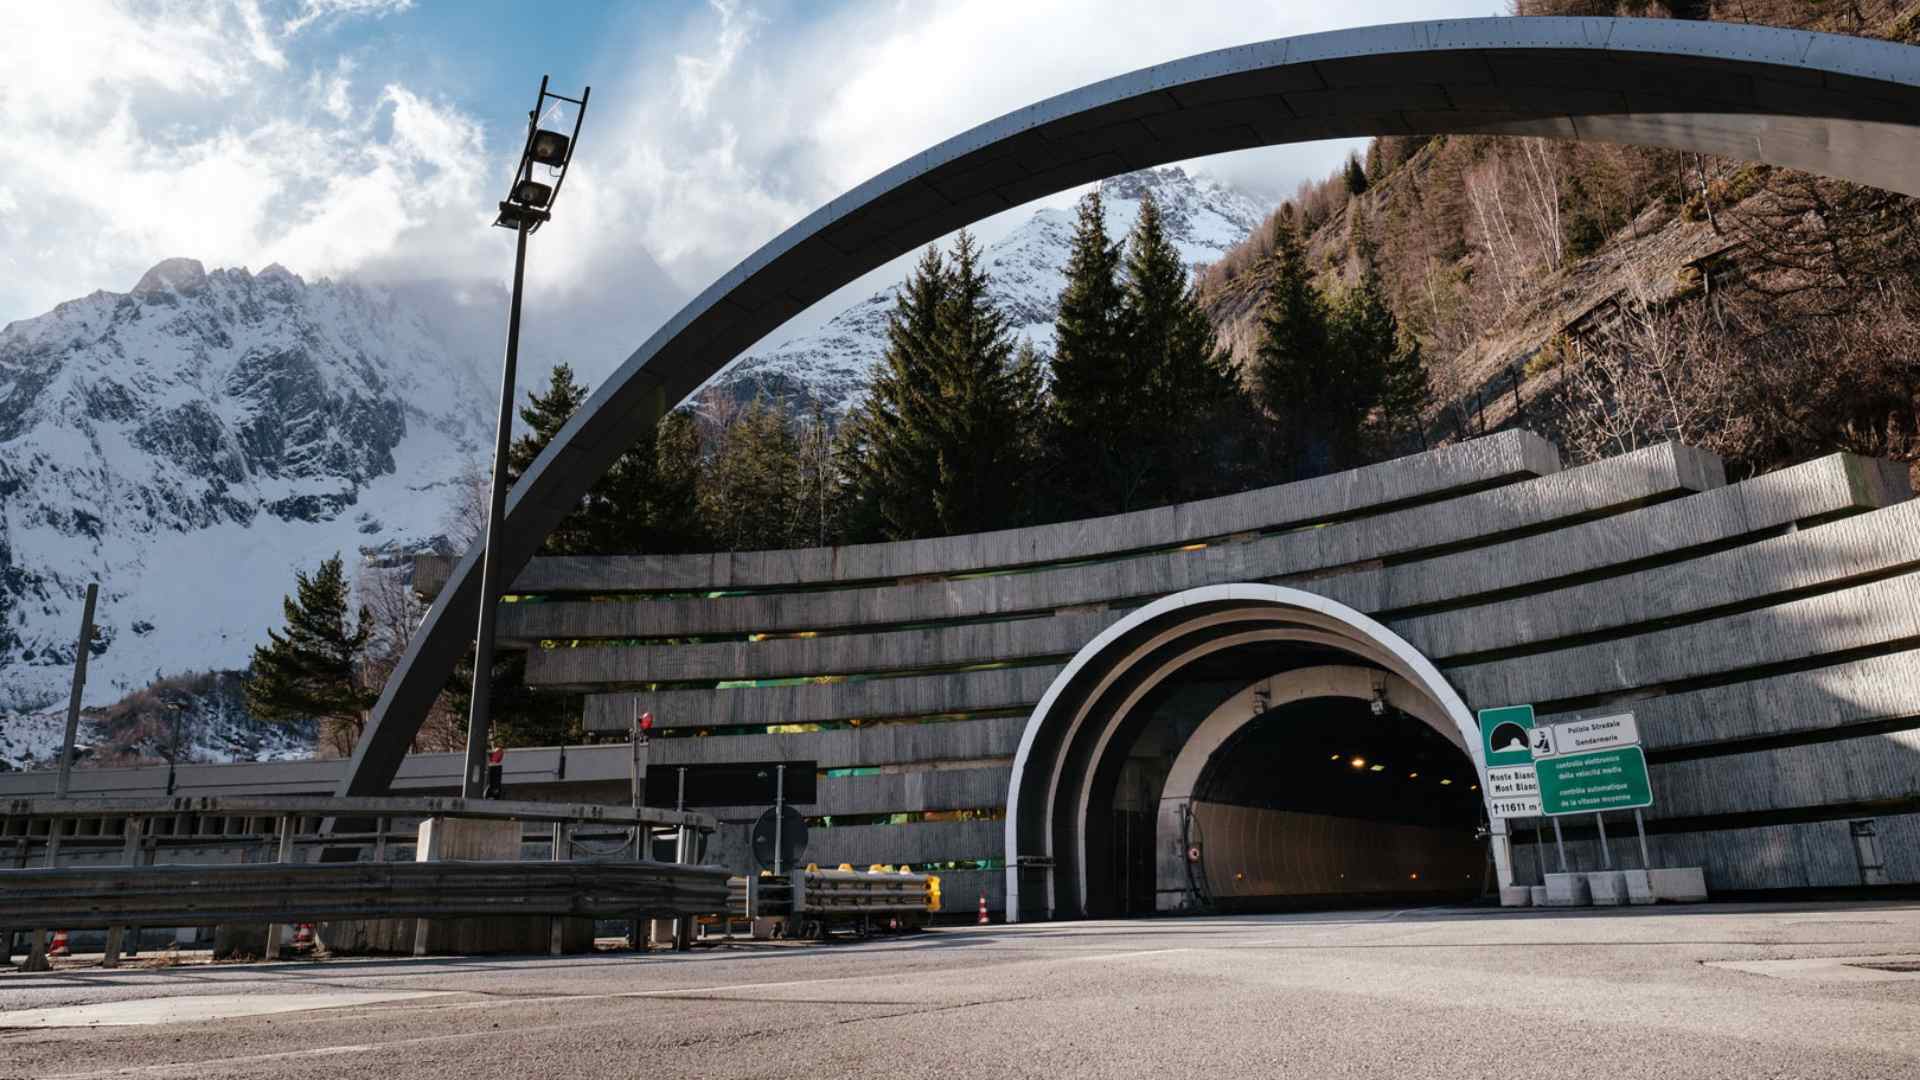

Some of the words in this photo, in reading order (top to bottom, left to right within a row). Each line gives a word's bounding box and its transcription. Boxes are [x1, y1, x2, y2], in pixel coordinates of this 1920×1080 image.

[1568, 726, 1589, 734] Polizia
[1592, 720, 1620, 731] Stradale
[1575, 735, 1617, 746] Gendarmerie
[1490, 774, 1512, 782] Monte
[1514, 772, 1534, 780] Bianc
[1495, 784, 1512, 792] Mont
[1516, 783, 1536, 791] Blanc
[1502, 803, 1526, 812] 11611
